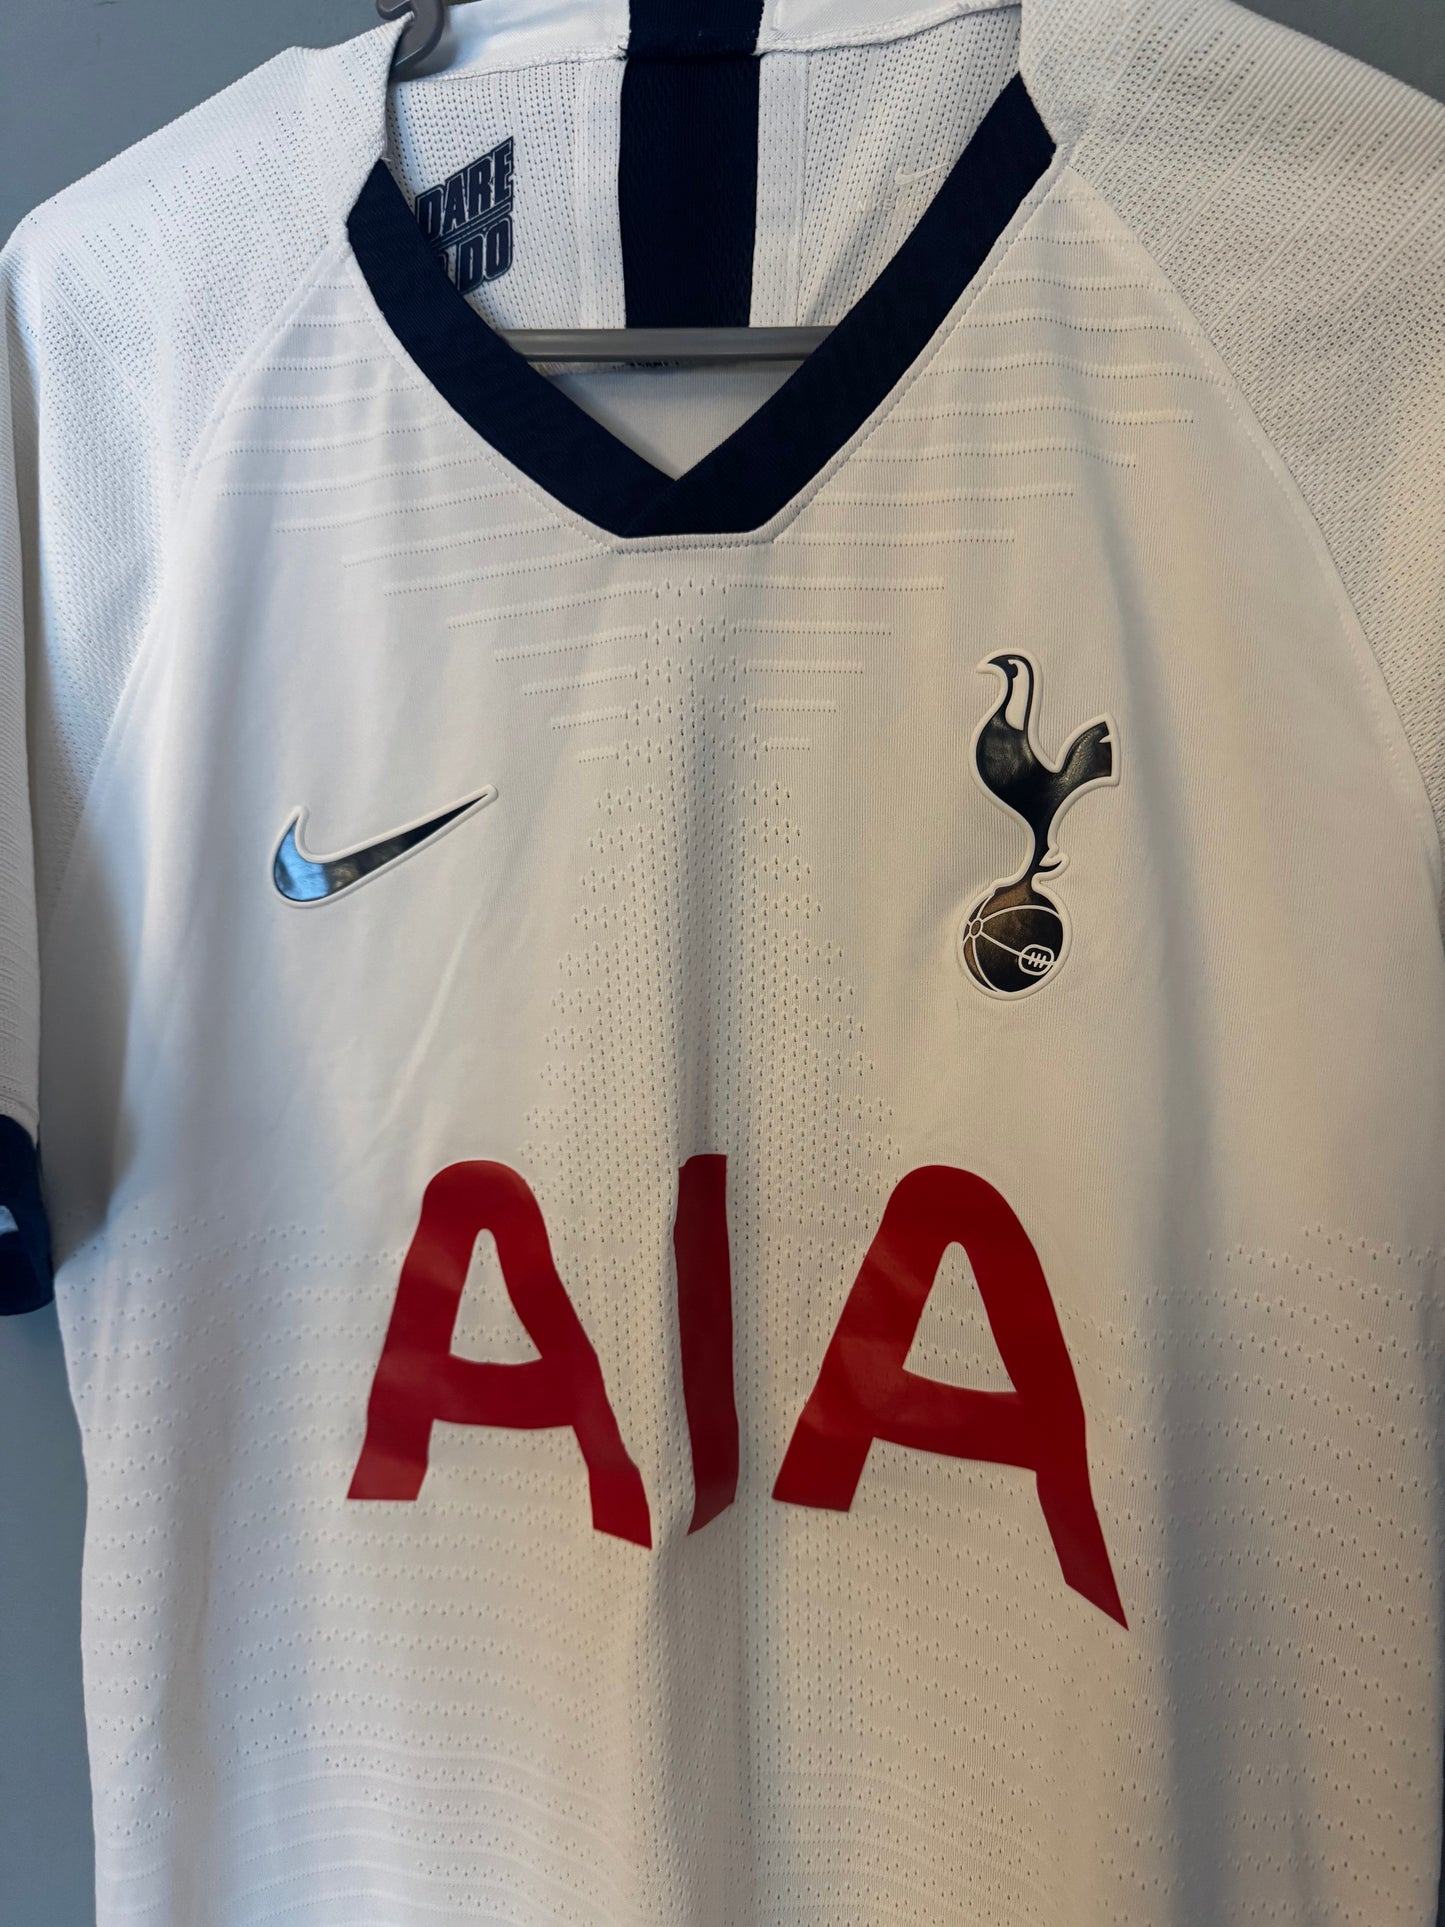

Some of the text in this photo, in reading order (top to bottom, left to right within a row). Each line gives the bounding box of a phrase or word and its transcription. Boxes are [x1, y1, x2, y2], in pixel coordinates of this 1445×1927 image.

[415, 136, 514, 241] DARE
[455, 215, 513, 294] DO
[347, 1155, 1128, 1629] AIA
